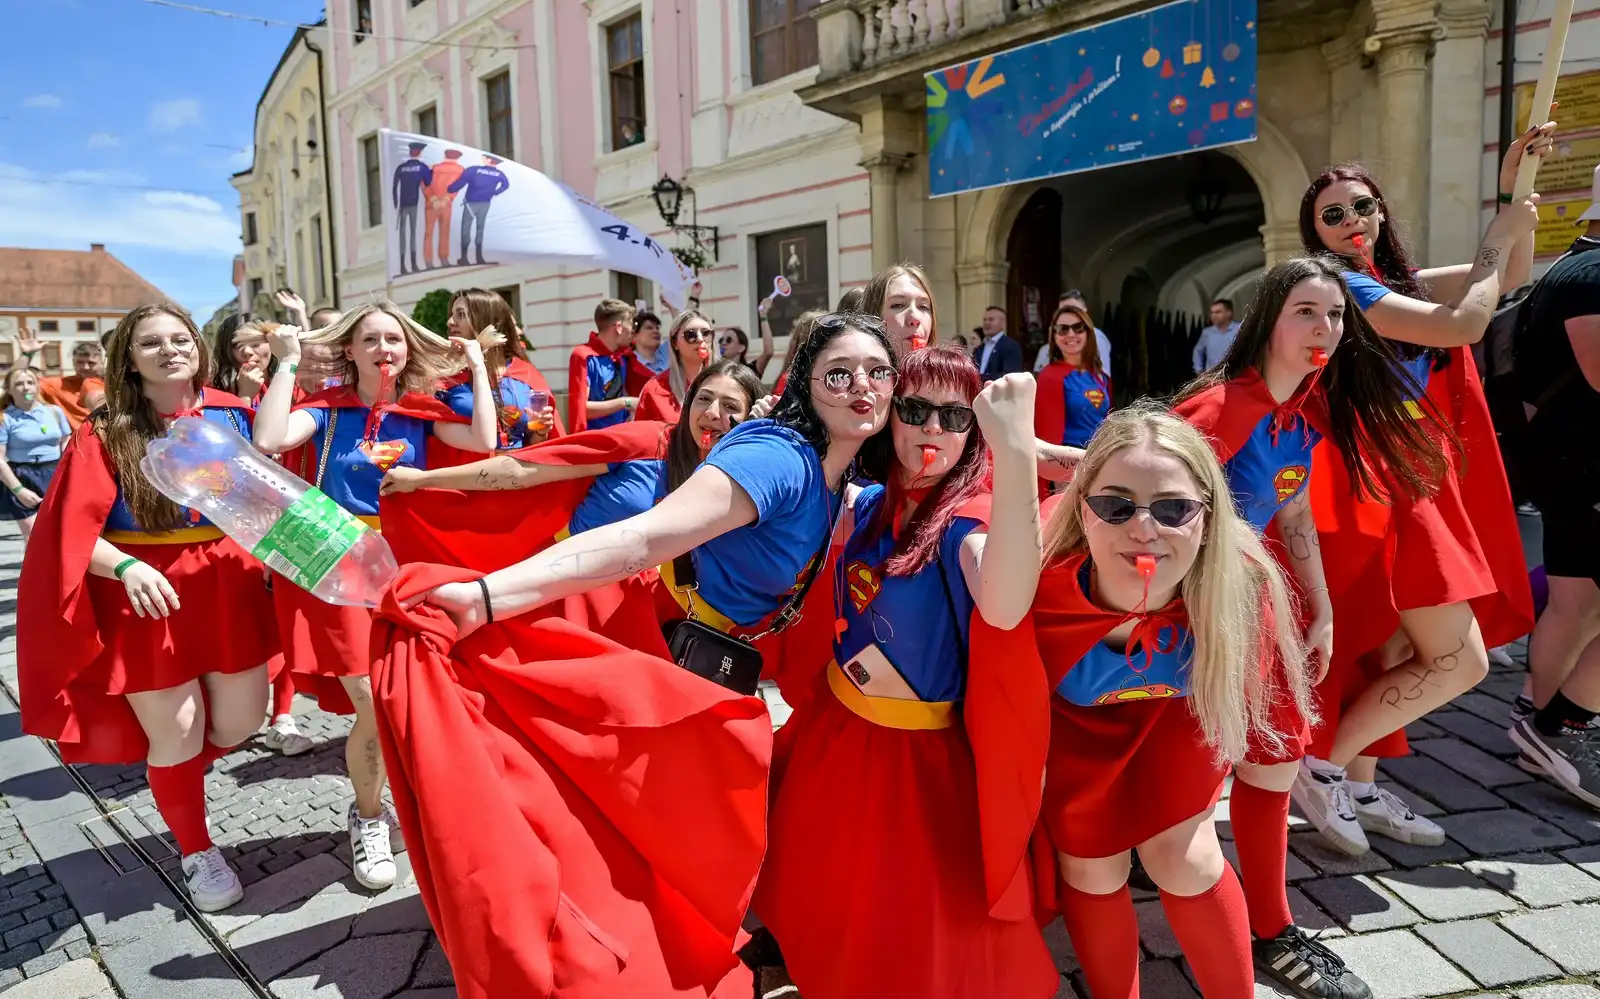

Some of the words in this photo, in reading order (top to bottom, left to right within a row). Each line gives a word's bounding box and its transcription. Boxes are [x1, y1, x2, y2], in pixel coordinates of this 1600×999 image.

[476, 168, 500, 177] POLICE
[826, 373, 851, 388] KISS
[873, 369, 891, 382] ME
